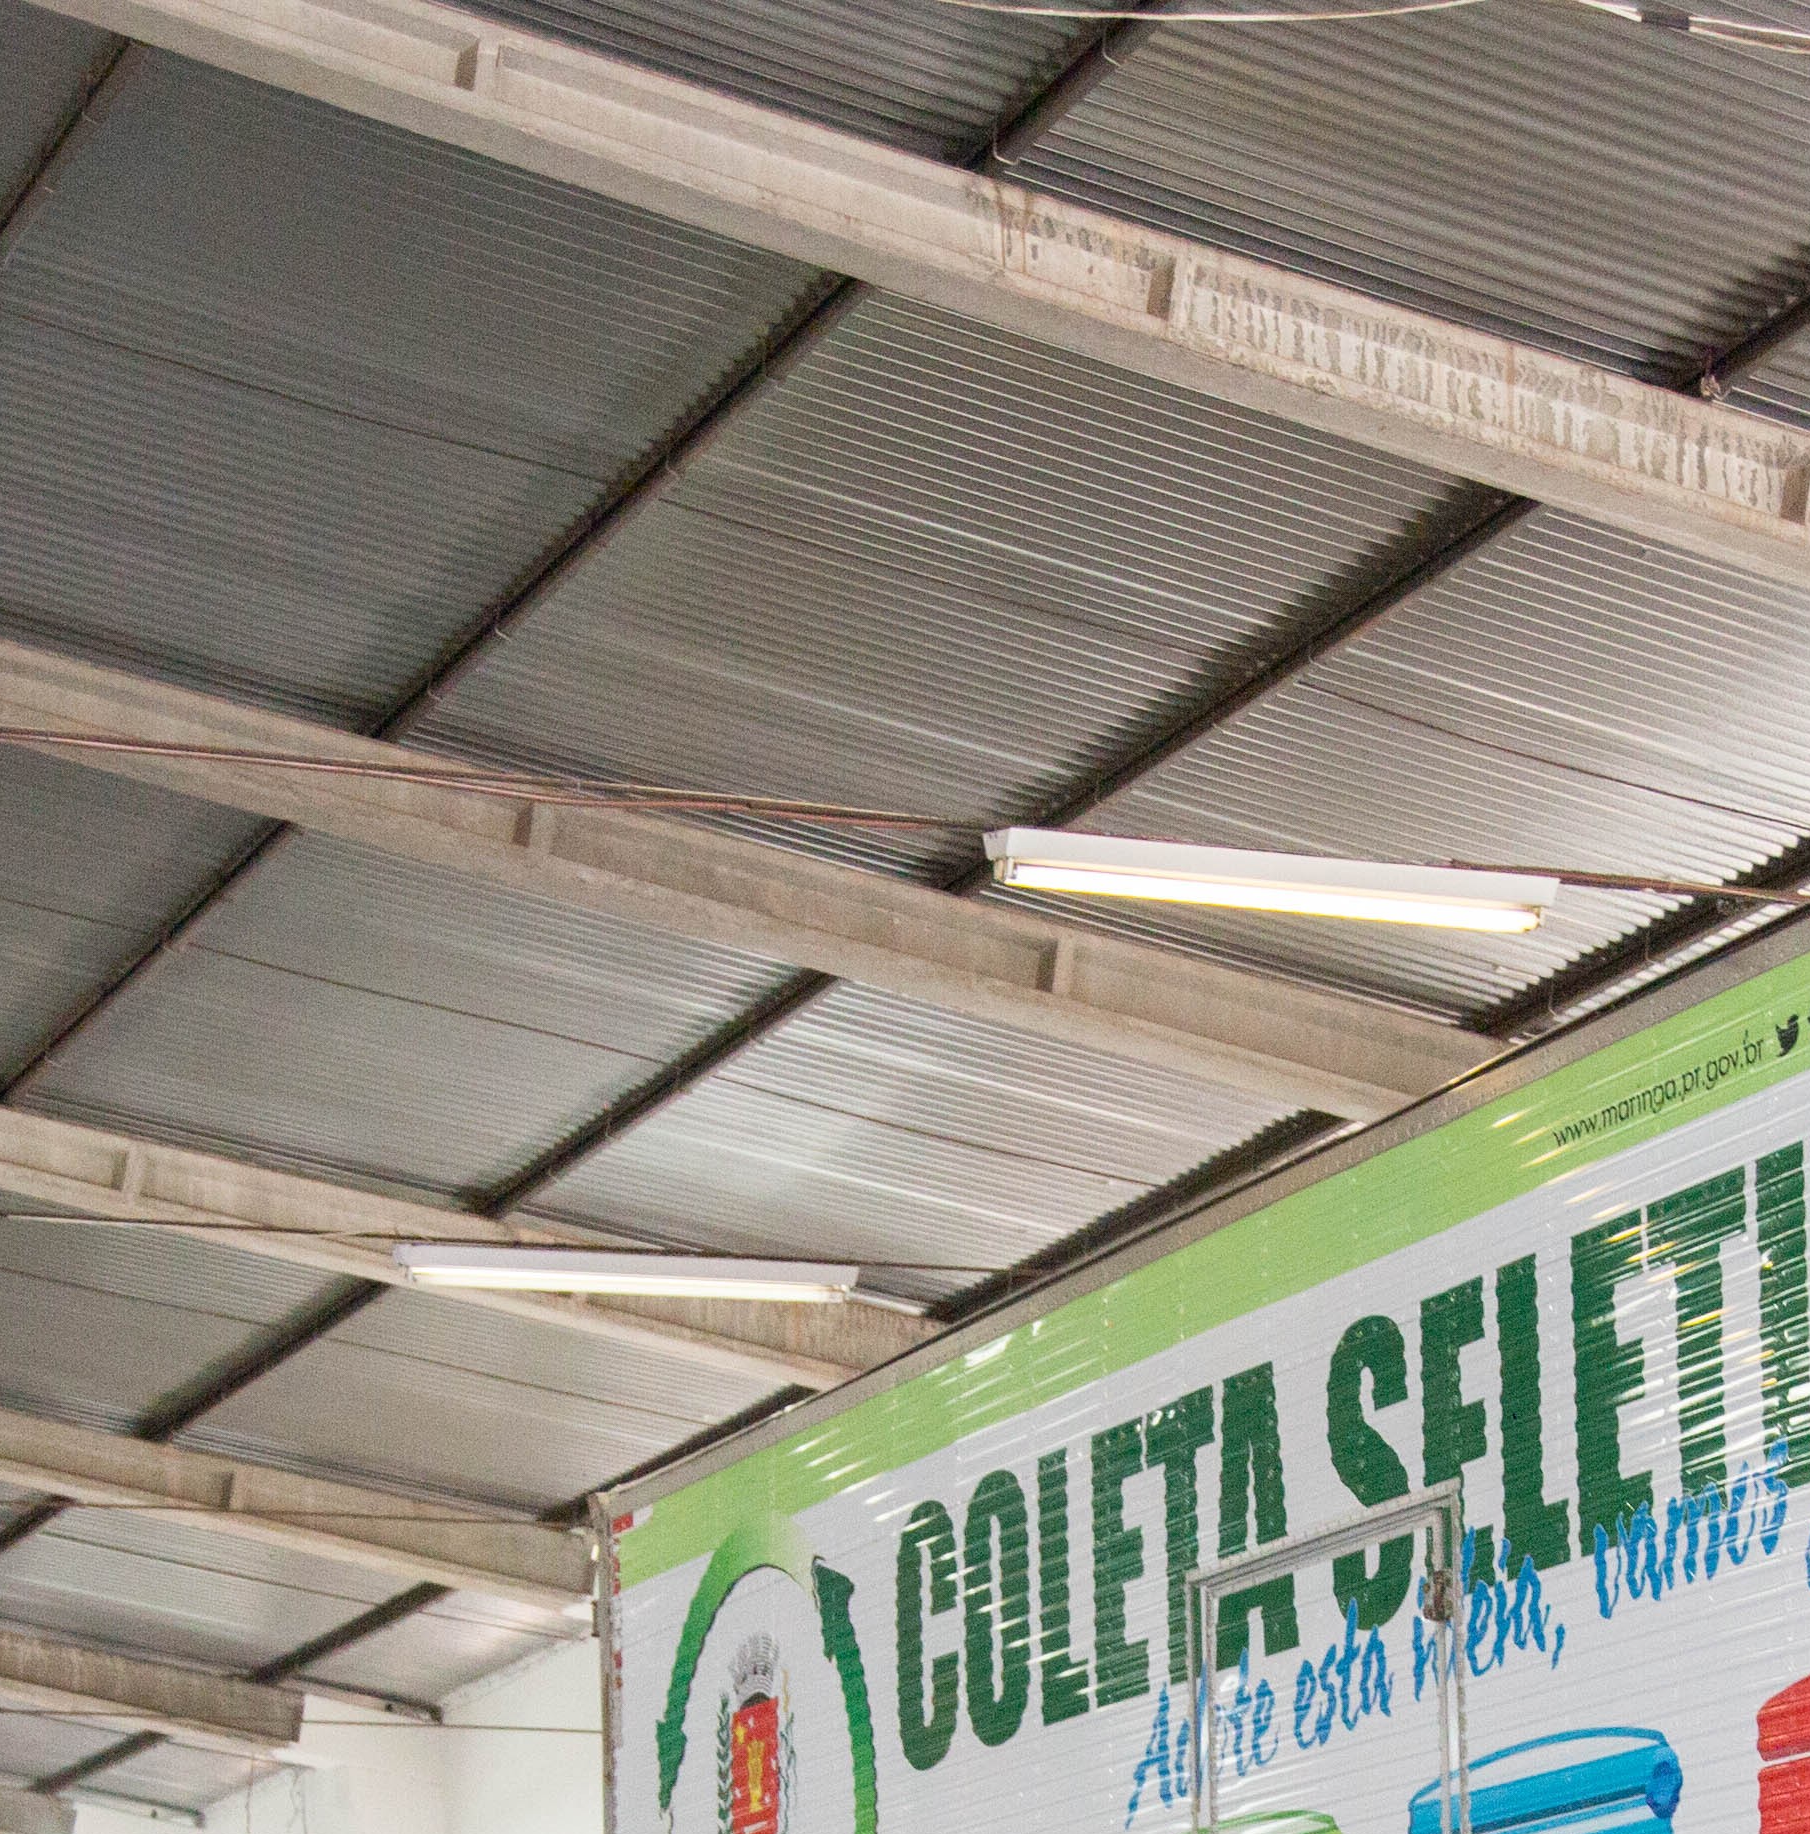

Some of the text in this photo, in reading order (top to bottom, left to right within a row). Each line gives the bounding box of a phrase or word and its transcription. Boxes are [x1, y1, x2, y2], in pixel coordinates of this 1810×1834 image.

[1552, 1031, 1766, 1149] www.maringa.pr.gov.br
[896, 1359, 1301, 1772] COLETA
[1294, 1597, 1393, 1749] esta
[1593, 1435, 1788, 1619] vamos
